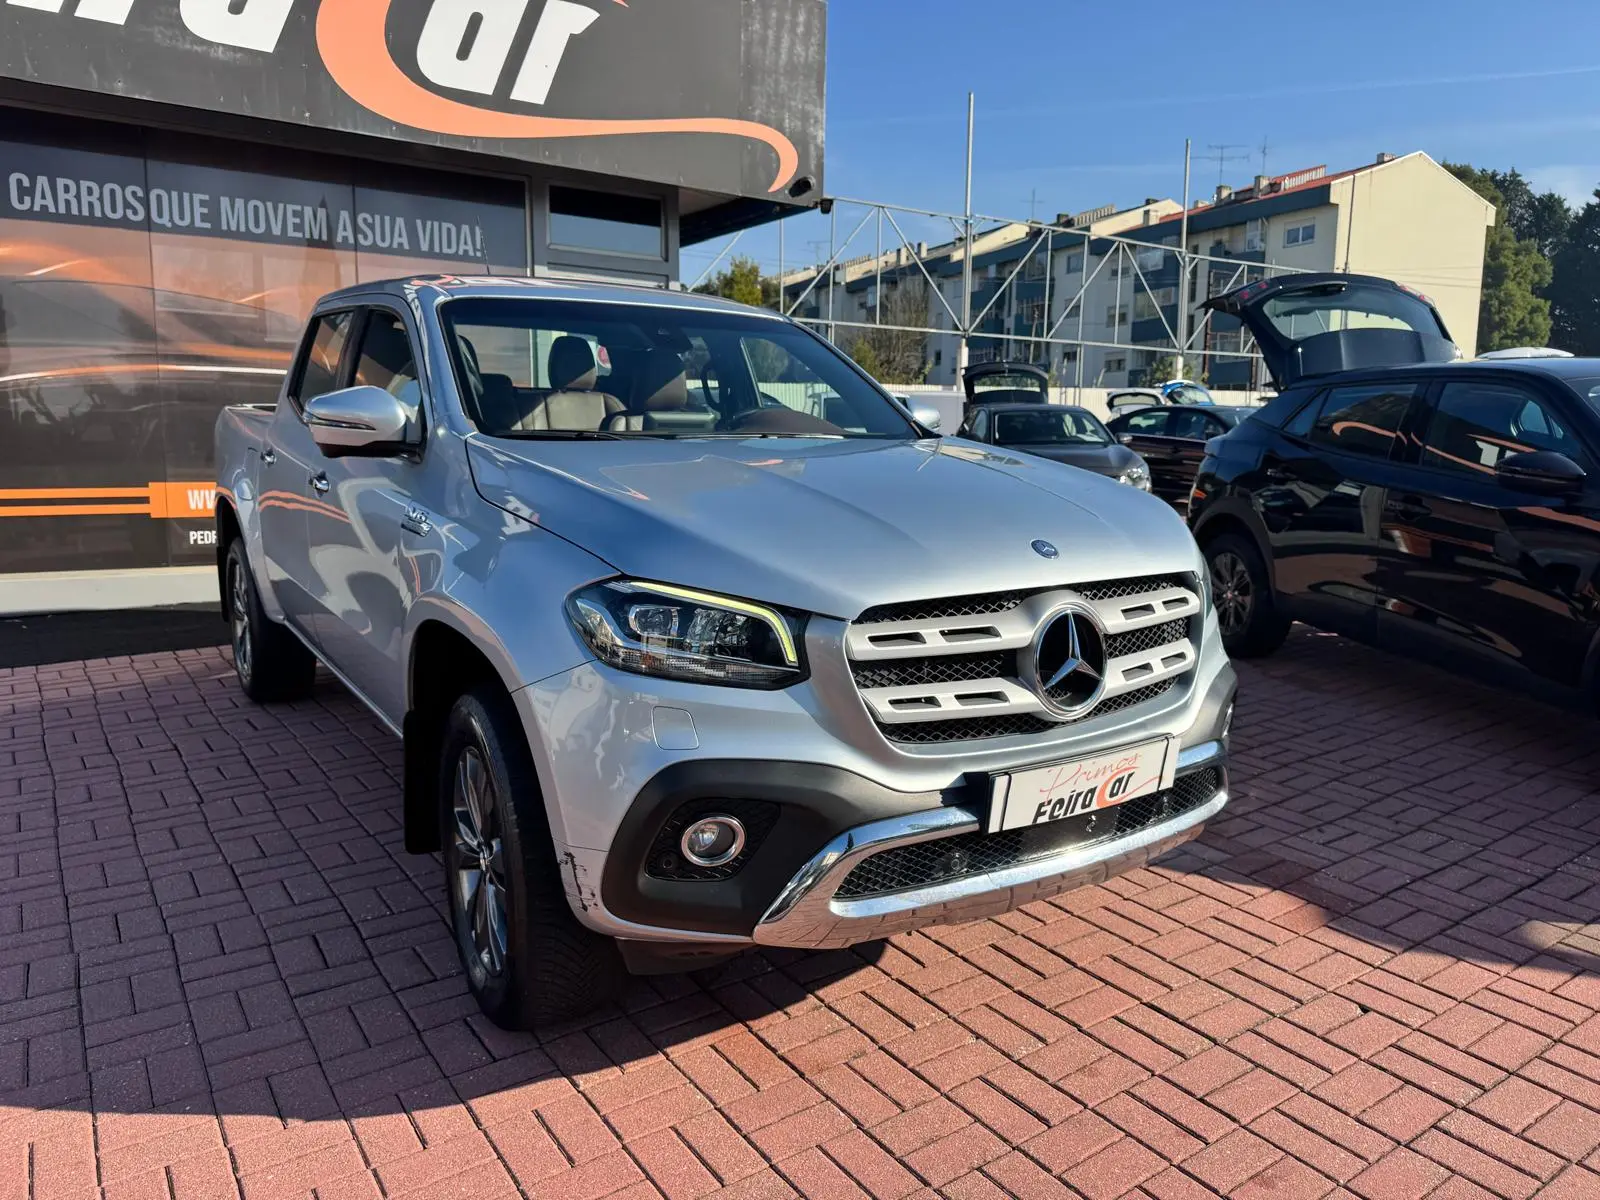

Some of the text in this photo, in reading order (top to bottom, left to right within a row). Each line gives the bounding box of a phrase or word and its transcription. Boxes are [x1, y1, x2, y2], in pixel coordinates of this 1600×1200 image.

[8, 172, 482, 257] CARROS QUE MOVEM A SUA VIDA!
